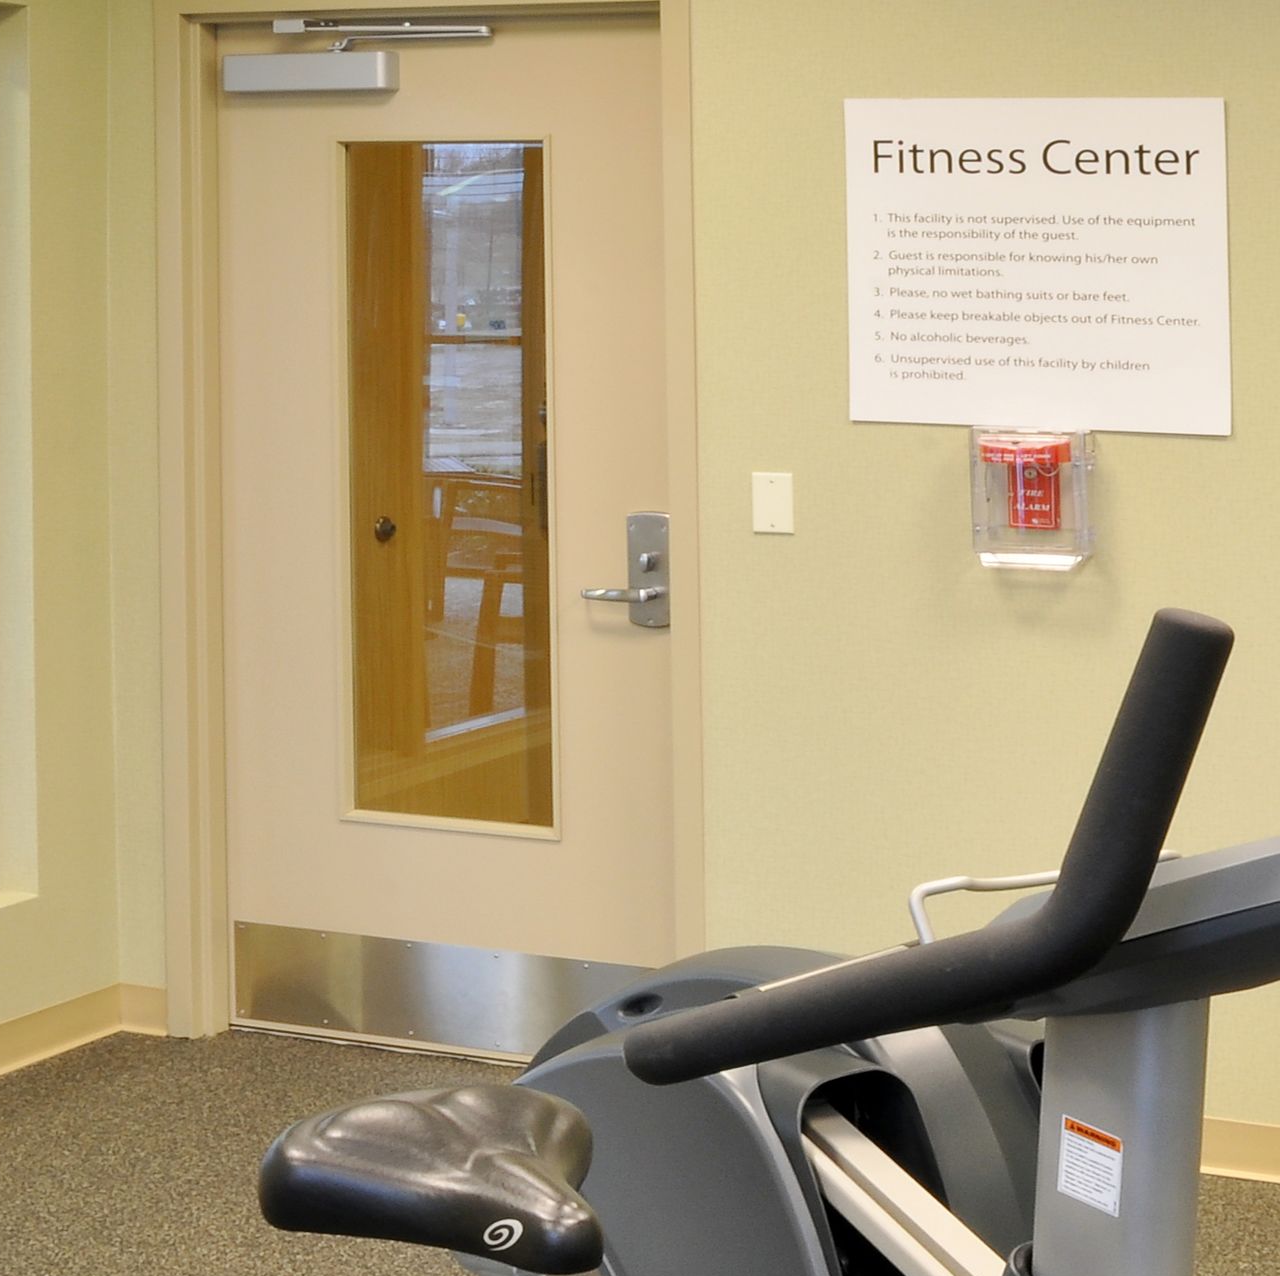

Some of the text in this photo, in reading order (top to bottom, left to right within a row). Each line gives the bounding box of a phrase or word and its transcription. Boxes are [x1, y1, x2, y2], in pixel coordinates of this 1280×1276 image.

[873, 139, 1199, 175] Fitness Center
[873, 212, 1195, 228] 1. This facility is not supervised. Use of the equipment
[887, 228, 1079, 242] is the responsibility of the guest.
[873, 249, 1158, 265] 2. Guest is responsible for knowing his/her own
[887, 265, 1003, 277] physical limitations.
[874, 286, 883, 296] 3.
[932, 290, 948, 298] no
[950, 290, 972, 298] wet
[975, 288, 1023, 302] bathing
[1025, 290, 1054, 300] suits
[1056, 292, 1070, 300] or
[1072, 290, 1100, 301] bare
[1102, 290, 1129, 302] feet.
[873, 308, 1200, 326] 4. Please keep breakable objects out of Fitness Center.
[875, 330, 1029, 346] 5. No alcoholic beverages.
[874, 353, 1150, 371] 6. Unsupervised use of this facility by children
[889, 369, 966, 380] is prohibited.
[1076, 1124, 1117, 1148] WARNING
